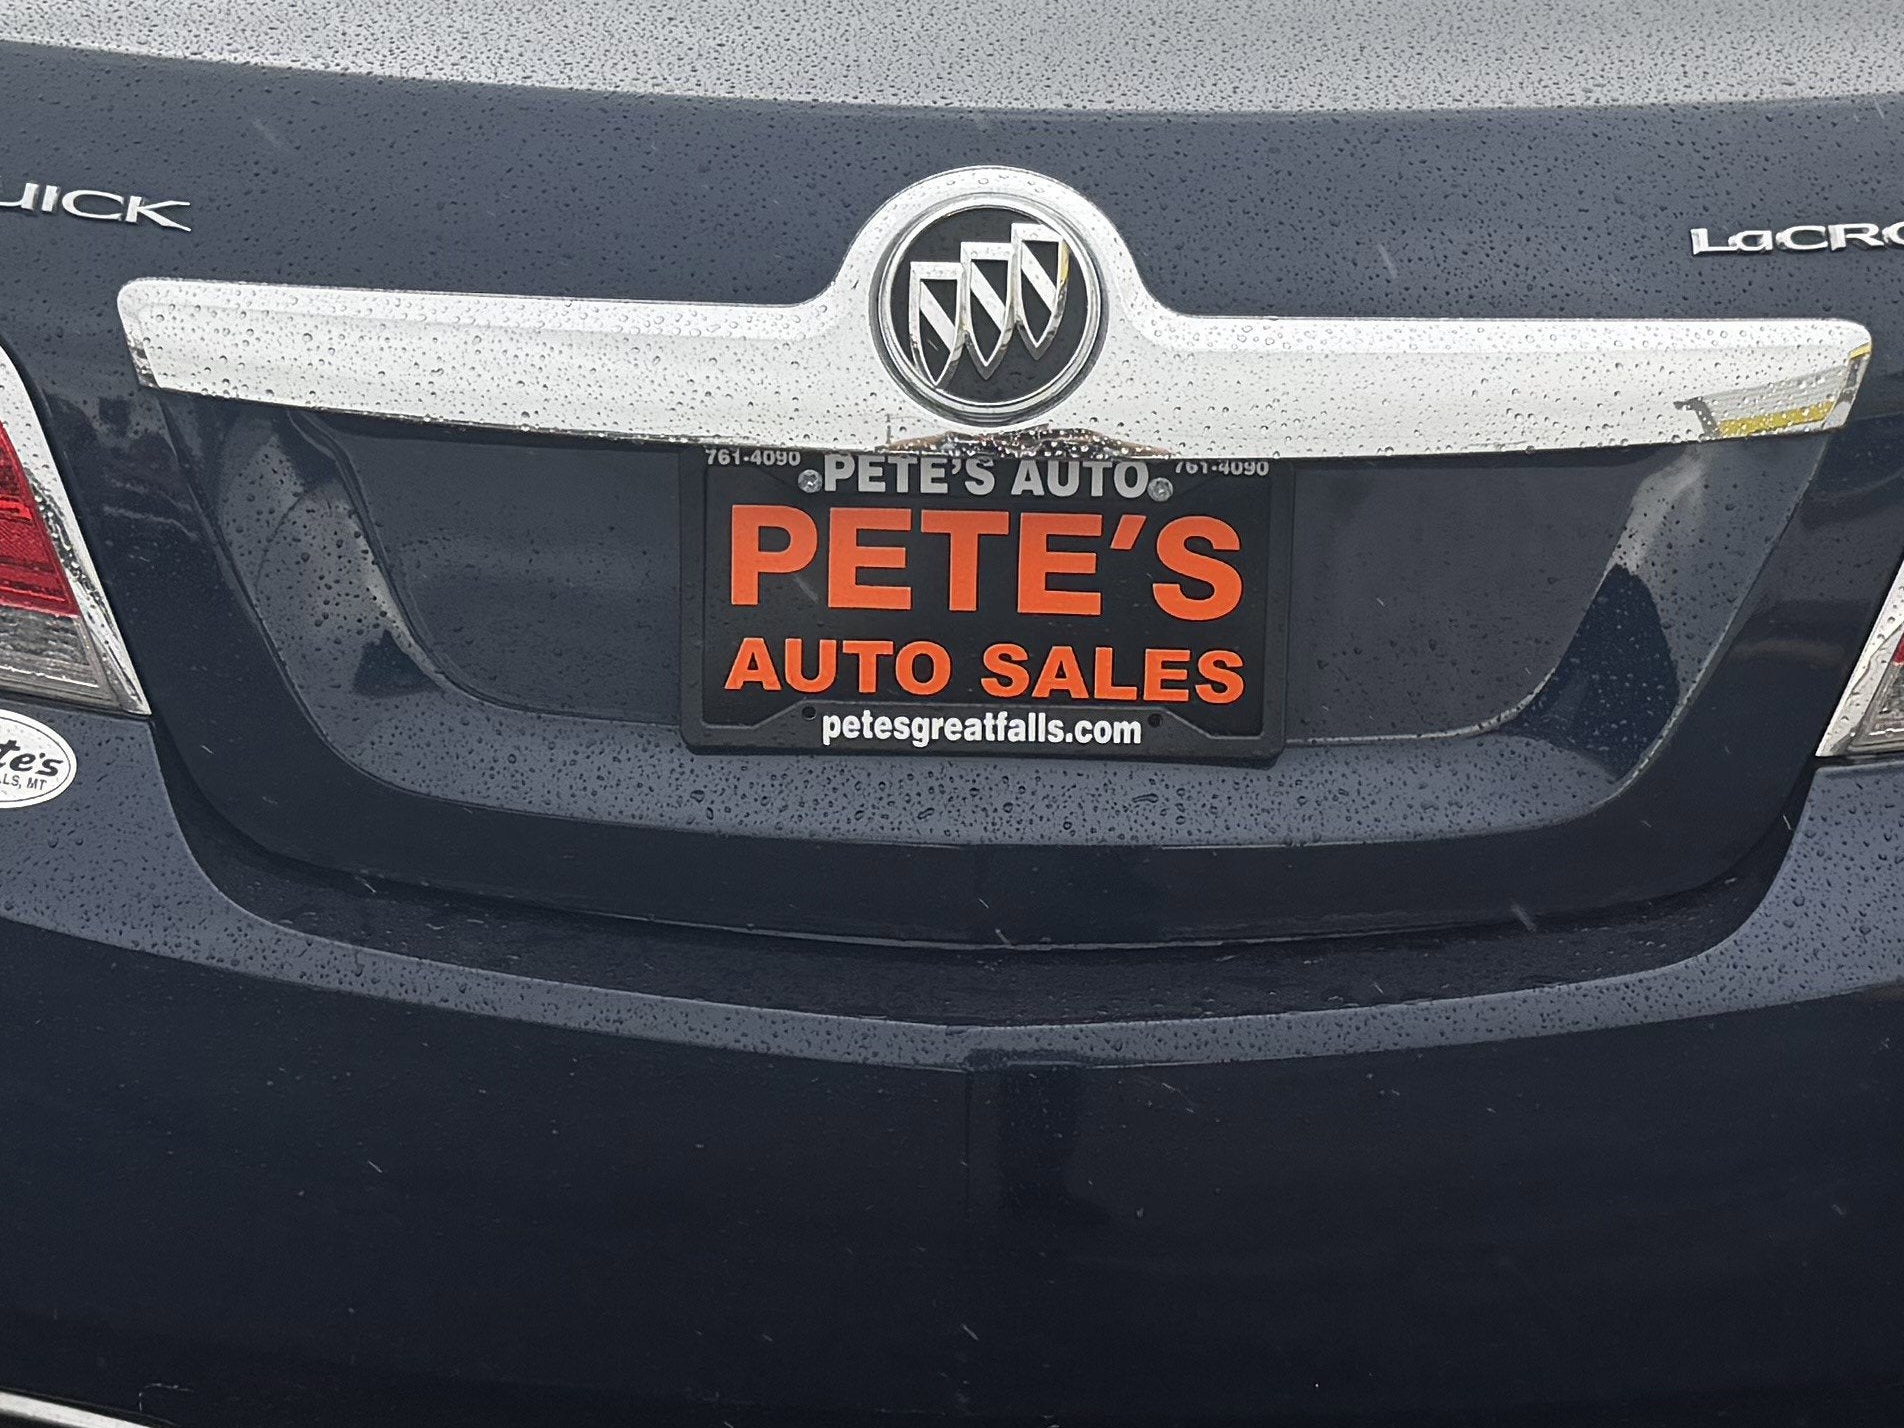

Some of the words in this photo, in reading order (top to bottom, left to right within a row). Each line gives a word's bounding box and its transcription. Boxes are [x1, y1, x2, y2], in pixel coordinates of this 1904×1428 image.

[824, 452, 996, 496] PETE'S
[1010, 459, 1150, 498] AUTO
[731, 504, 1244, 621] PETE'S
[725, 638, 953, 696] AUTO
[981, 644, 1245, 704] SALES
[822, 709, 1142, 748] petesgreatfalls.com
[27, 776, 48, 791] MT
